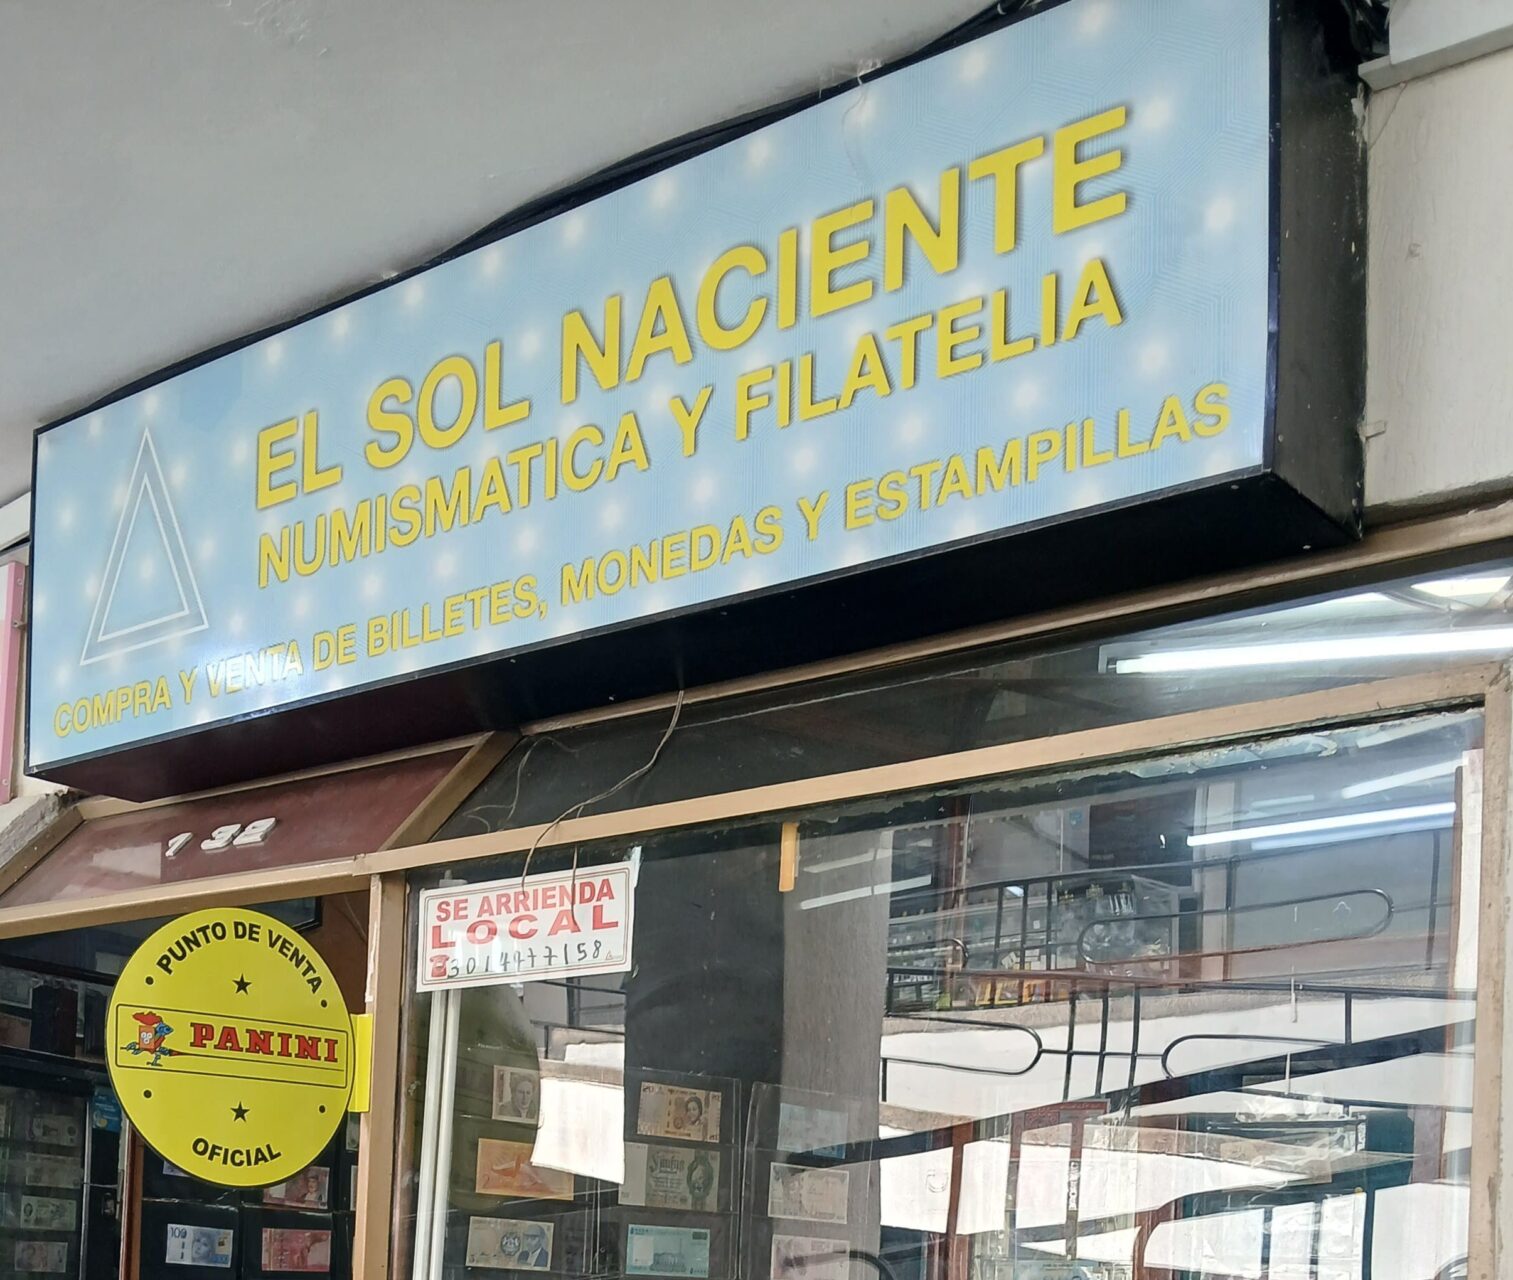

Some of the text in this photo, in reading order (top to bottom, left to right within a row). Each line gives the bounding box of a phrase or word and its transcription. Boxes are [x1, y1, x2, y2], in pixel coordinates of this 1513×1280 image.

[256, 105, 1130, 509] EL SOL NACIENTE
[258, 257, 1122, 588] NUMISMATICA Y FILATELIA
[53, 382, 1231, 740] COMPRA Y VENTA DE BILLETES, MONEDAS Y ESTAMPILLAS
[431, 904, 619, 949] LOCAL
[436, 878, 615, 922] SE ARRIENDA
[156, 921, 323, 994] PUNTO DE VENTA
[189, 1022, 338, 1063] PANINI
[191, 1137, 282, 1166] OFICIAL
